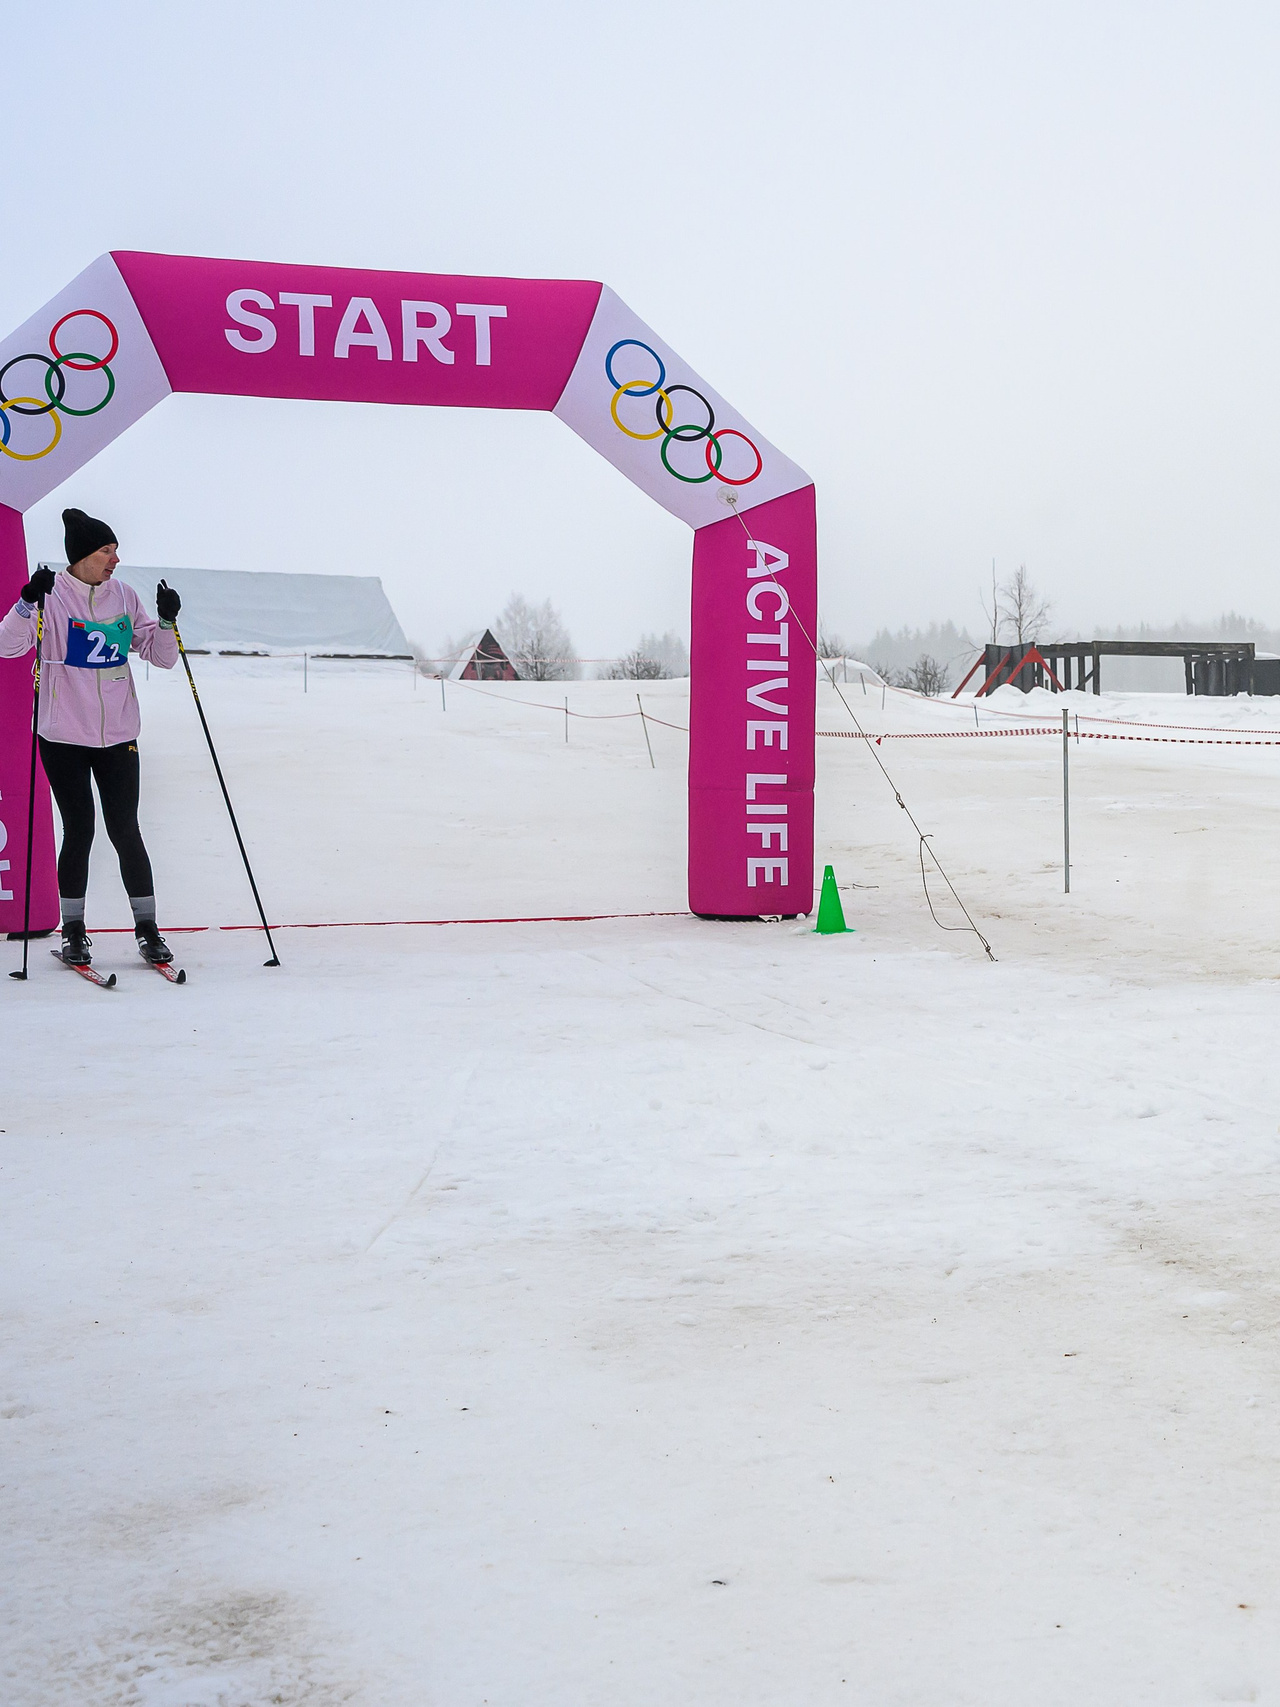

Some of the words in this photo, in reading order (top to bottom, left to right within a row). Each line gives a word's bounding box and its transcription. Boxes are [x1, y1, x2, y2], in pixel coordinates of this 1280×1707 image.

[225, 288, 508, 366] START
[747, 540, 789, 751] ACTIVE
[746, 774, 788, 887] LIFE
